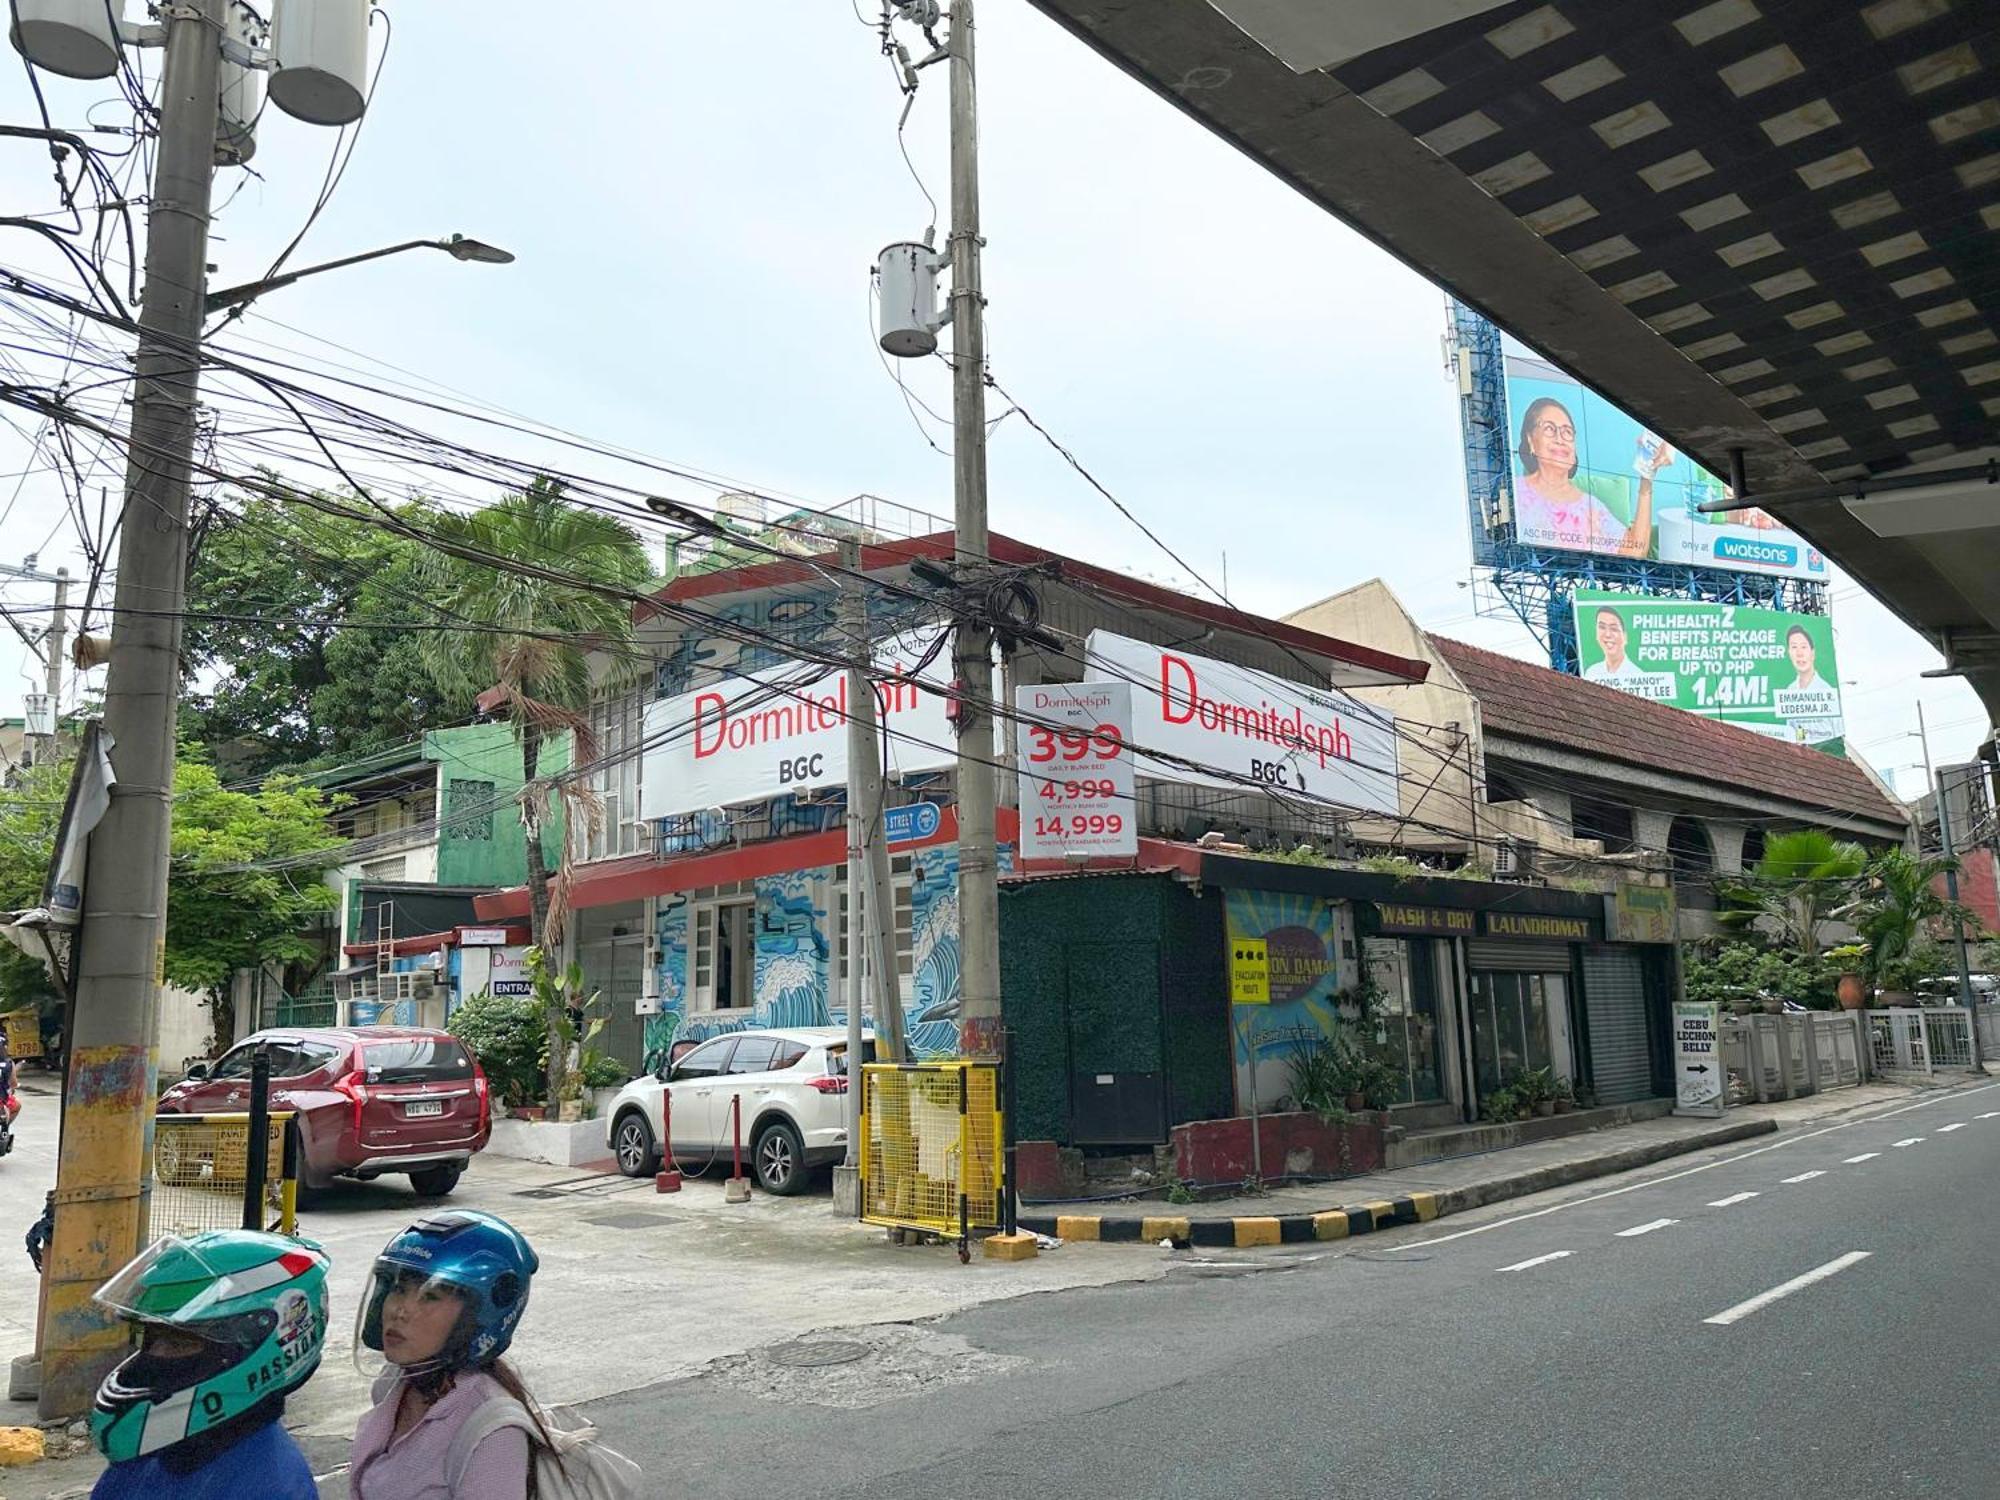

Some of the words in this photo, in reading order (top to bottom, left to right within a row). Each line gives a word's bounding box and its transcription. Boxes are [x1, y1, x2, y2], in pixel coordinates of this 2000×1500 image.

[1681, 540, 1699, 551] only
[1700, 543, 1709, 552] at
[1724, 542, 1788, 561] watsons
[1633, 614, 1720, 629] PHILHEALTH
[1722, 606, 1735, 628] Z
[1641, 630, 1709, 644] BENEFITS
[1712, 629, 1776, 644] PACKAGE
[1638, 647, 1668, 661] FOR
[1671, 646, 1722, 661] BREAST
[1728, 645, 1785, 660] CANCER
[1679, 661, 1699, 675] UP
[1703, 660, 1723, 675] TO
[1725, 660, 1755, 674] PHP
[1654, 686, 1671, 697] LEE
[1692, 675, 1768, 706] 1.4M!
[1779, 692, 1825, 703] EMMANUEL
[1035, 693, 1110, 710] Dormitelsph
[1780, 704, 1817, 714] LEDESMA
[1820, 703, 1832, 713] JR.
[694, 662, 917, 759] Dormitelph
[1161, 653, 1351, 769] Dormitelsph
[1030, 723, 1122, 762] 399
[779, 752, 823, 784] BGC
[1251, 758, 1288, 786] BGC
[1040, 779, 1115, 803] 4,999
[890, 813, 913, 830] STREET
[1034, 814, 1122, 838] 14,999
[1381, 904, 1426, 927] WASH
[1431, 911, 1441, 927] &
[1447, 911, 1474, 929] DRY
[1489, 914, 1589, 938] LAUNDROMAT
[496, 983, 531, 993] ENTRA
[1243, 984, 1259, 994] ROUTE
[1683, 1019, 1709, 1030] CEBU
[1676, 1031, 1717, 1041] LECHON
[1682, 1042, 1712, 1052] BELLY
[247, 1314, 319, 1393] PASSION
